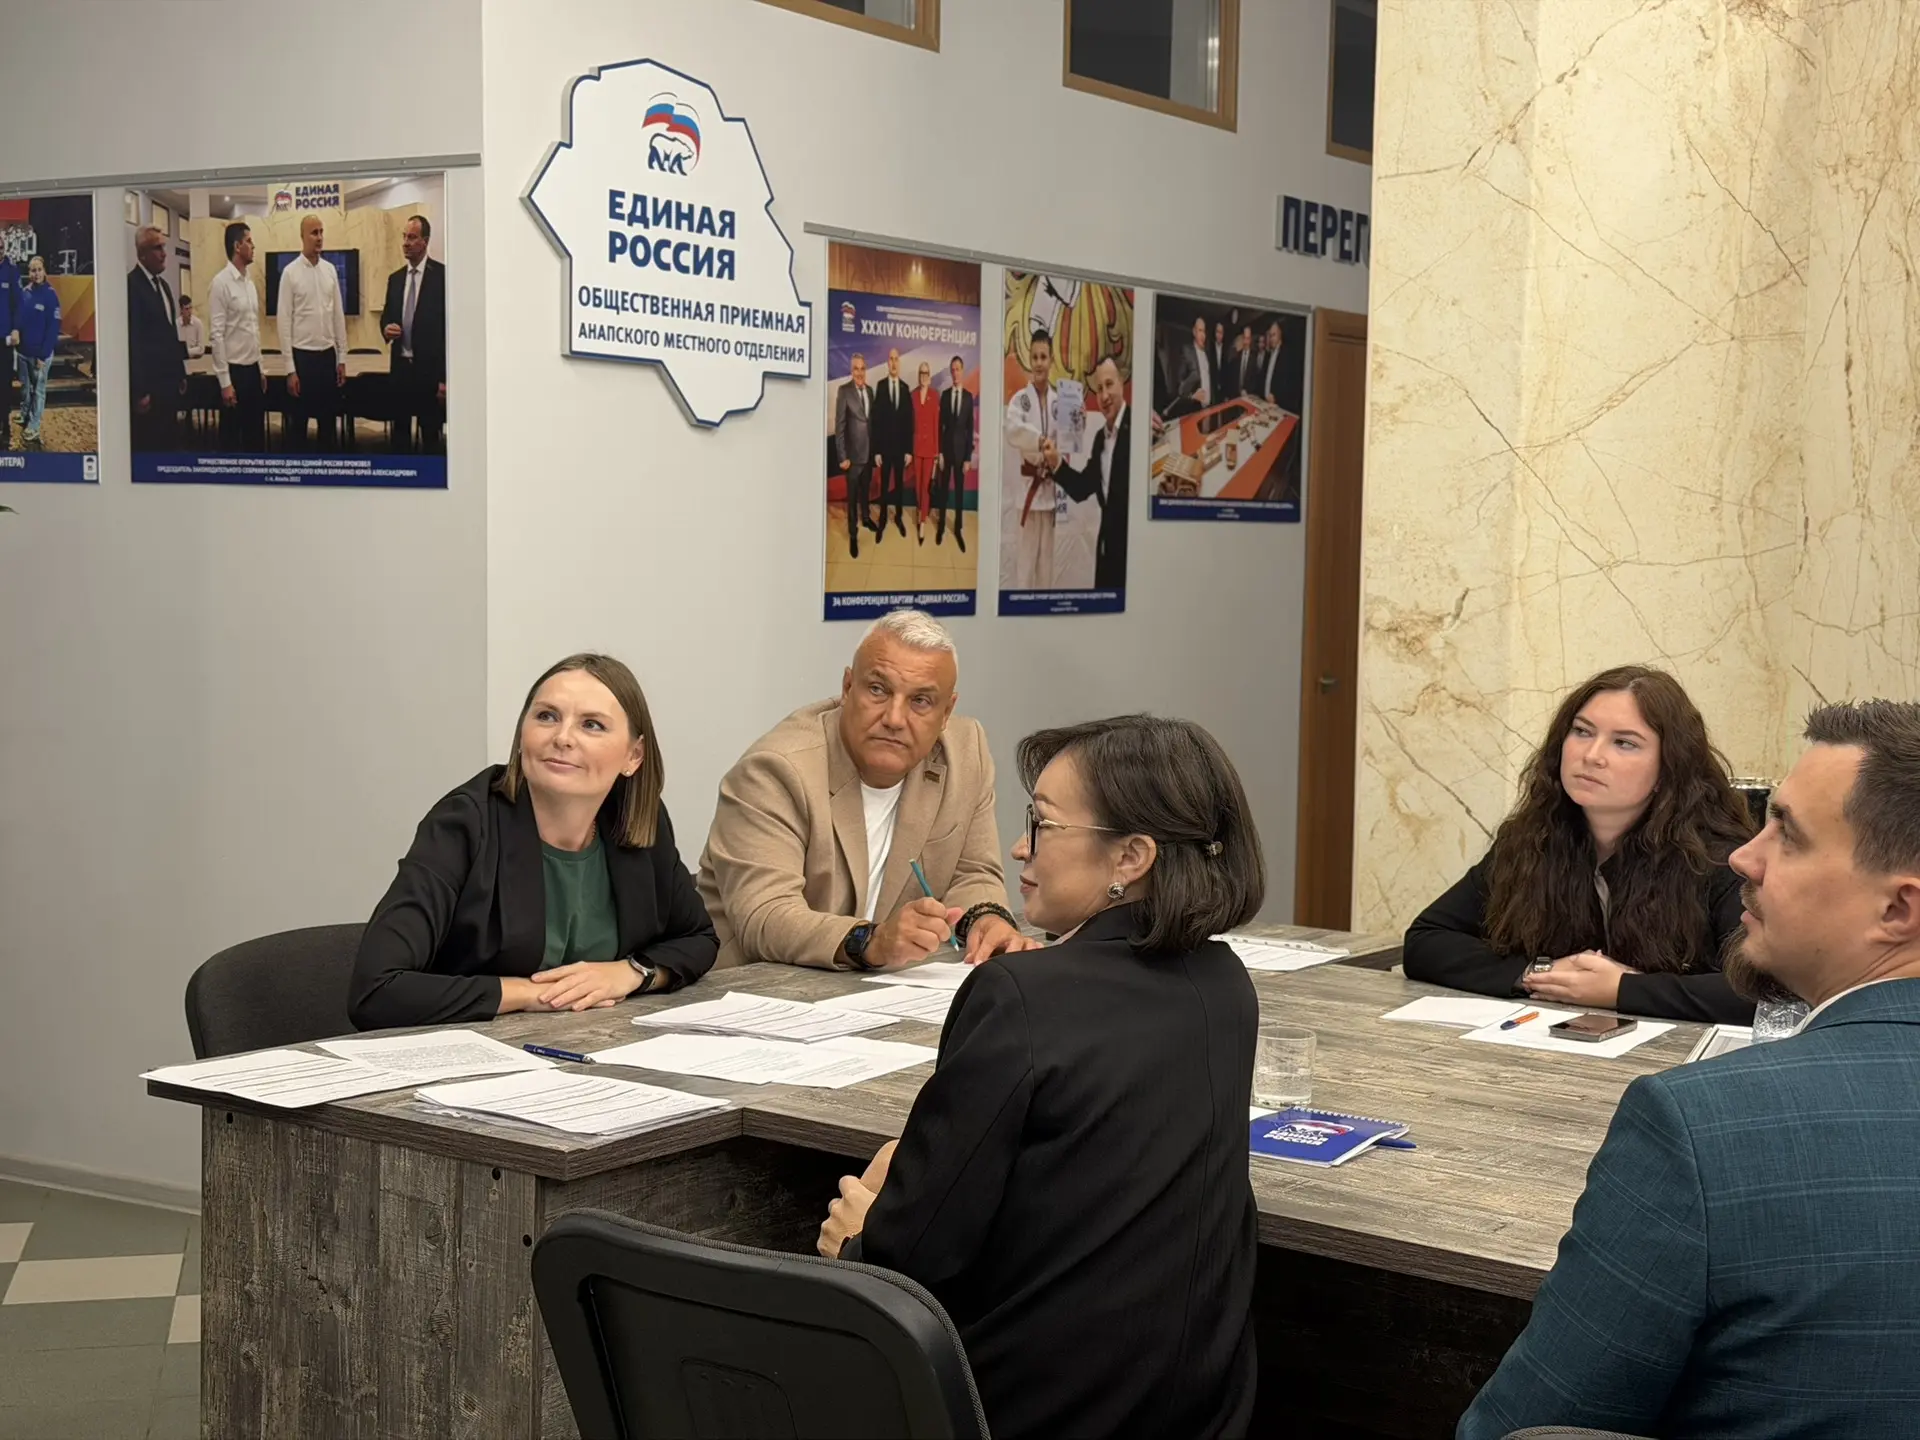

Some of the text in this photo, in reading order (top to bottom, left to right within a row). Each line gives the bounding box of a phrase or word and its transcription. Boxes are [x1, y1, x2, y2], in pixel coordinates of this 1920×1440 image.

[295, 184, 339, 197] ЕДИНАЯ
[295, 196, 339, 210] РОССИЯ
[608, 189, 736, 239] ЕДИНАЯ
[1281, 195, 1370, 265] ПЕРЕГ
[608, 230, 736, 281] РОССИЯ
[577, 285, 805, 334] ОБЩЕСТВЕННАЯ ПРИЕМНАЯ
[577, 322, 805, 364] АНАПСКОГО МЕСТНОГО ОТДЕЛЕНИЯ
[861, 319, 894, 337] XXXIV
[895, 322, 977, 347] КОНФЕРЕНЦИЯ
[842, 595, 888, 607] КОНФЕРЕНЦИЯ
[889, 595, 914, 605] ПАРТИИ
